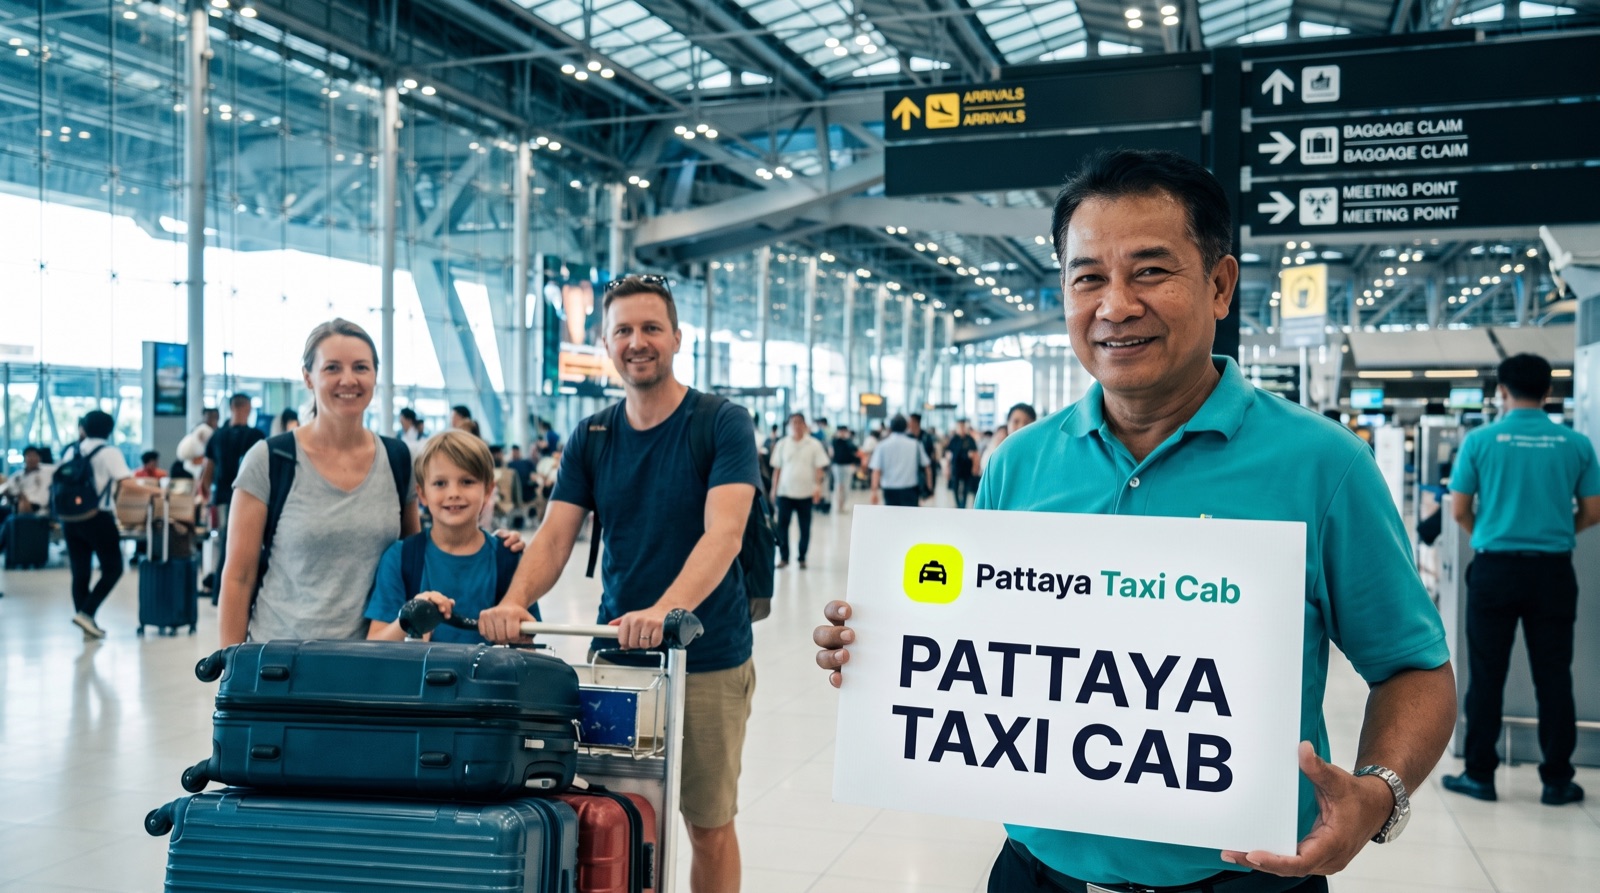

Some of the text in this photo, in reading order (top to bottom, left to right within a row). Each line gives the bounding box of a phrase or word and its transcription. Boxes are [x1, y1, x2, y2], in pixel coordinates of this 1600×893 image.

[963, 87, 1025, 103] ARRIVALS
[963, 109, 1026, 126] ARRIVALS
[1343, 118, 1463, 139] BAGGAGE CLAIM
[1343, 145, 1417, 163] BAGGAGE
[1420, 143, 1469, 158] CLAIM
[1342, 180, 1458, 199] MEETING POINT
[1342, 205, 1459, 223] MEETING POINT
[976, 563, 1241, 604] Pattaya Taxi Cab
[900, 634, 1233, 718] PATTAYA
[892, 704, 1234, 793] TAXI CAB
